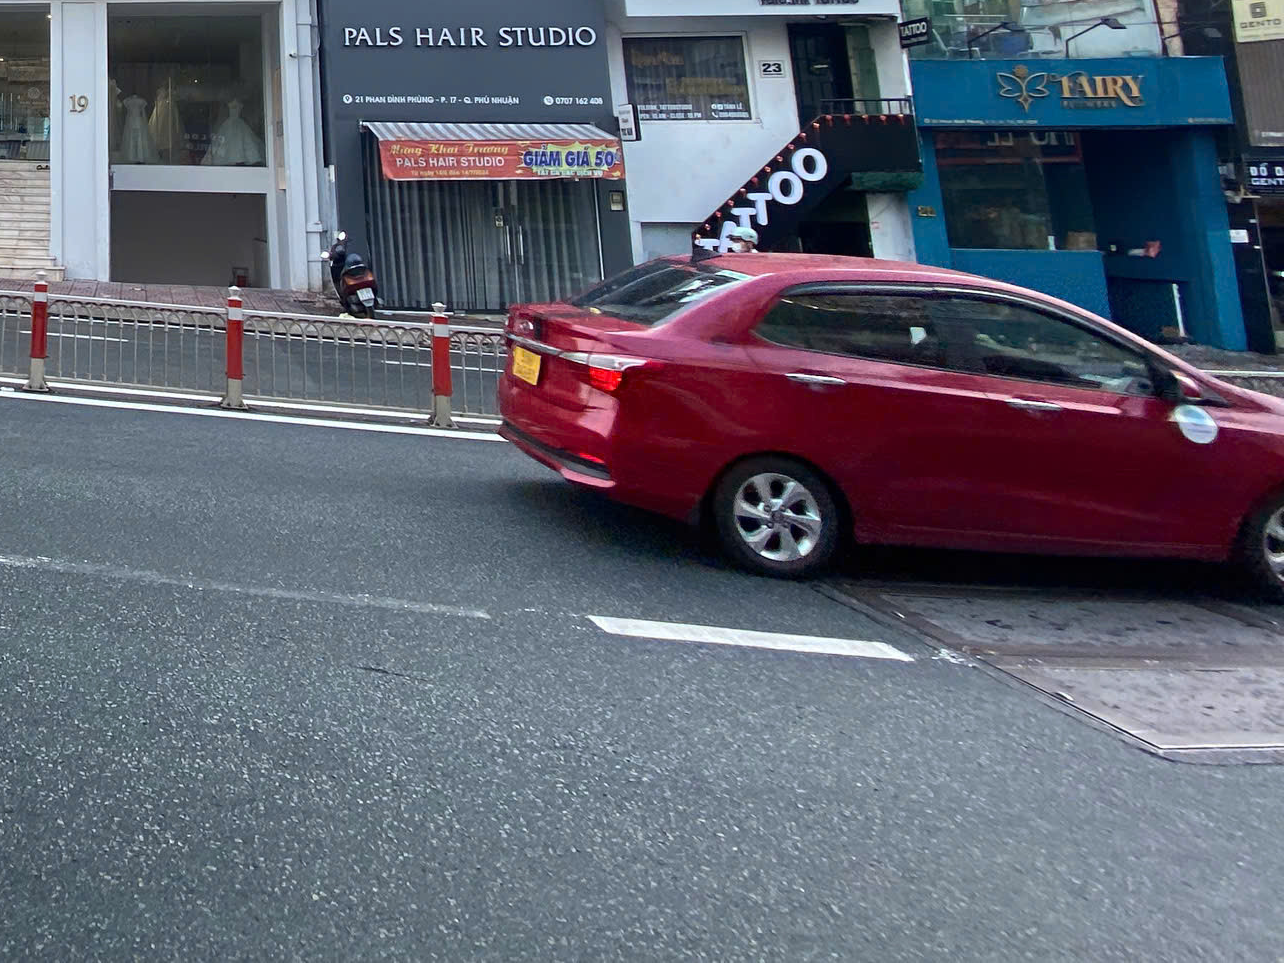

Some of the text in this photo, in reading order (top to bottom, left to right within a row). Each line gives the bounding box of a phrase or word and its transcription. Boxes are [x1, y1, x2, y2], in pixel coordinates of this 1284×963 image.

[343, 26, 596, 47] PALS HAIR STUDIO
[900, 22, 927, 37] TATTOO
[762, 63, 782, 73] 23
[69, 94, 88, 113] 19
[365, 96, 386, 104] PHAN
[474, 95, 489, 104] PHÚ
[491, 96, 519, 105] NHUẬN
[396, 156, 505, 168] PALS HAIR STUDIO
[523, 144, 562, 168] GIẢM
[565, 145, 592, 168] GIÁ
